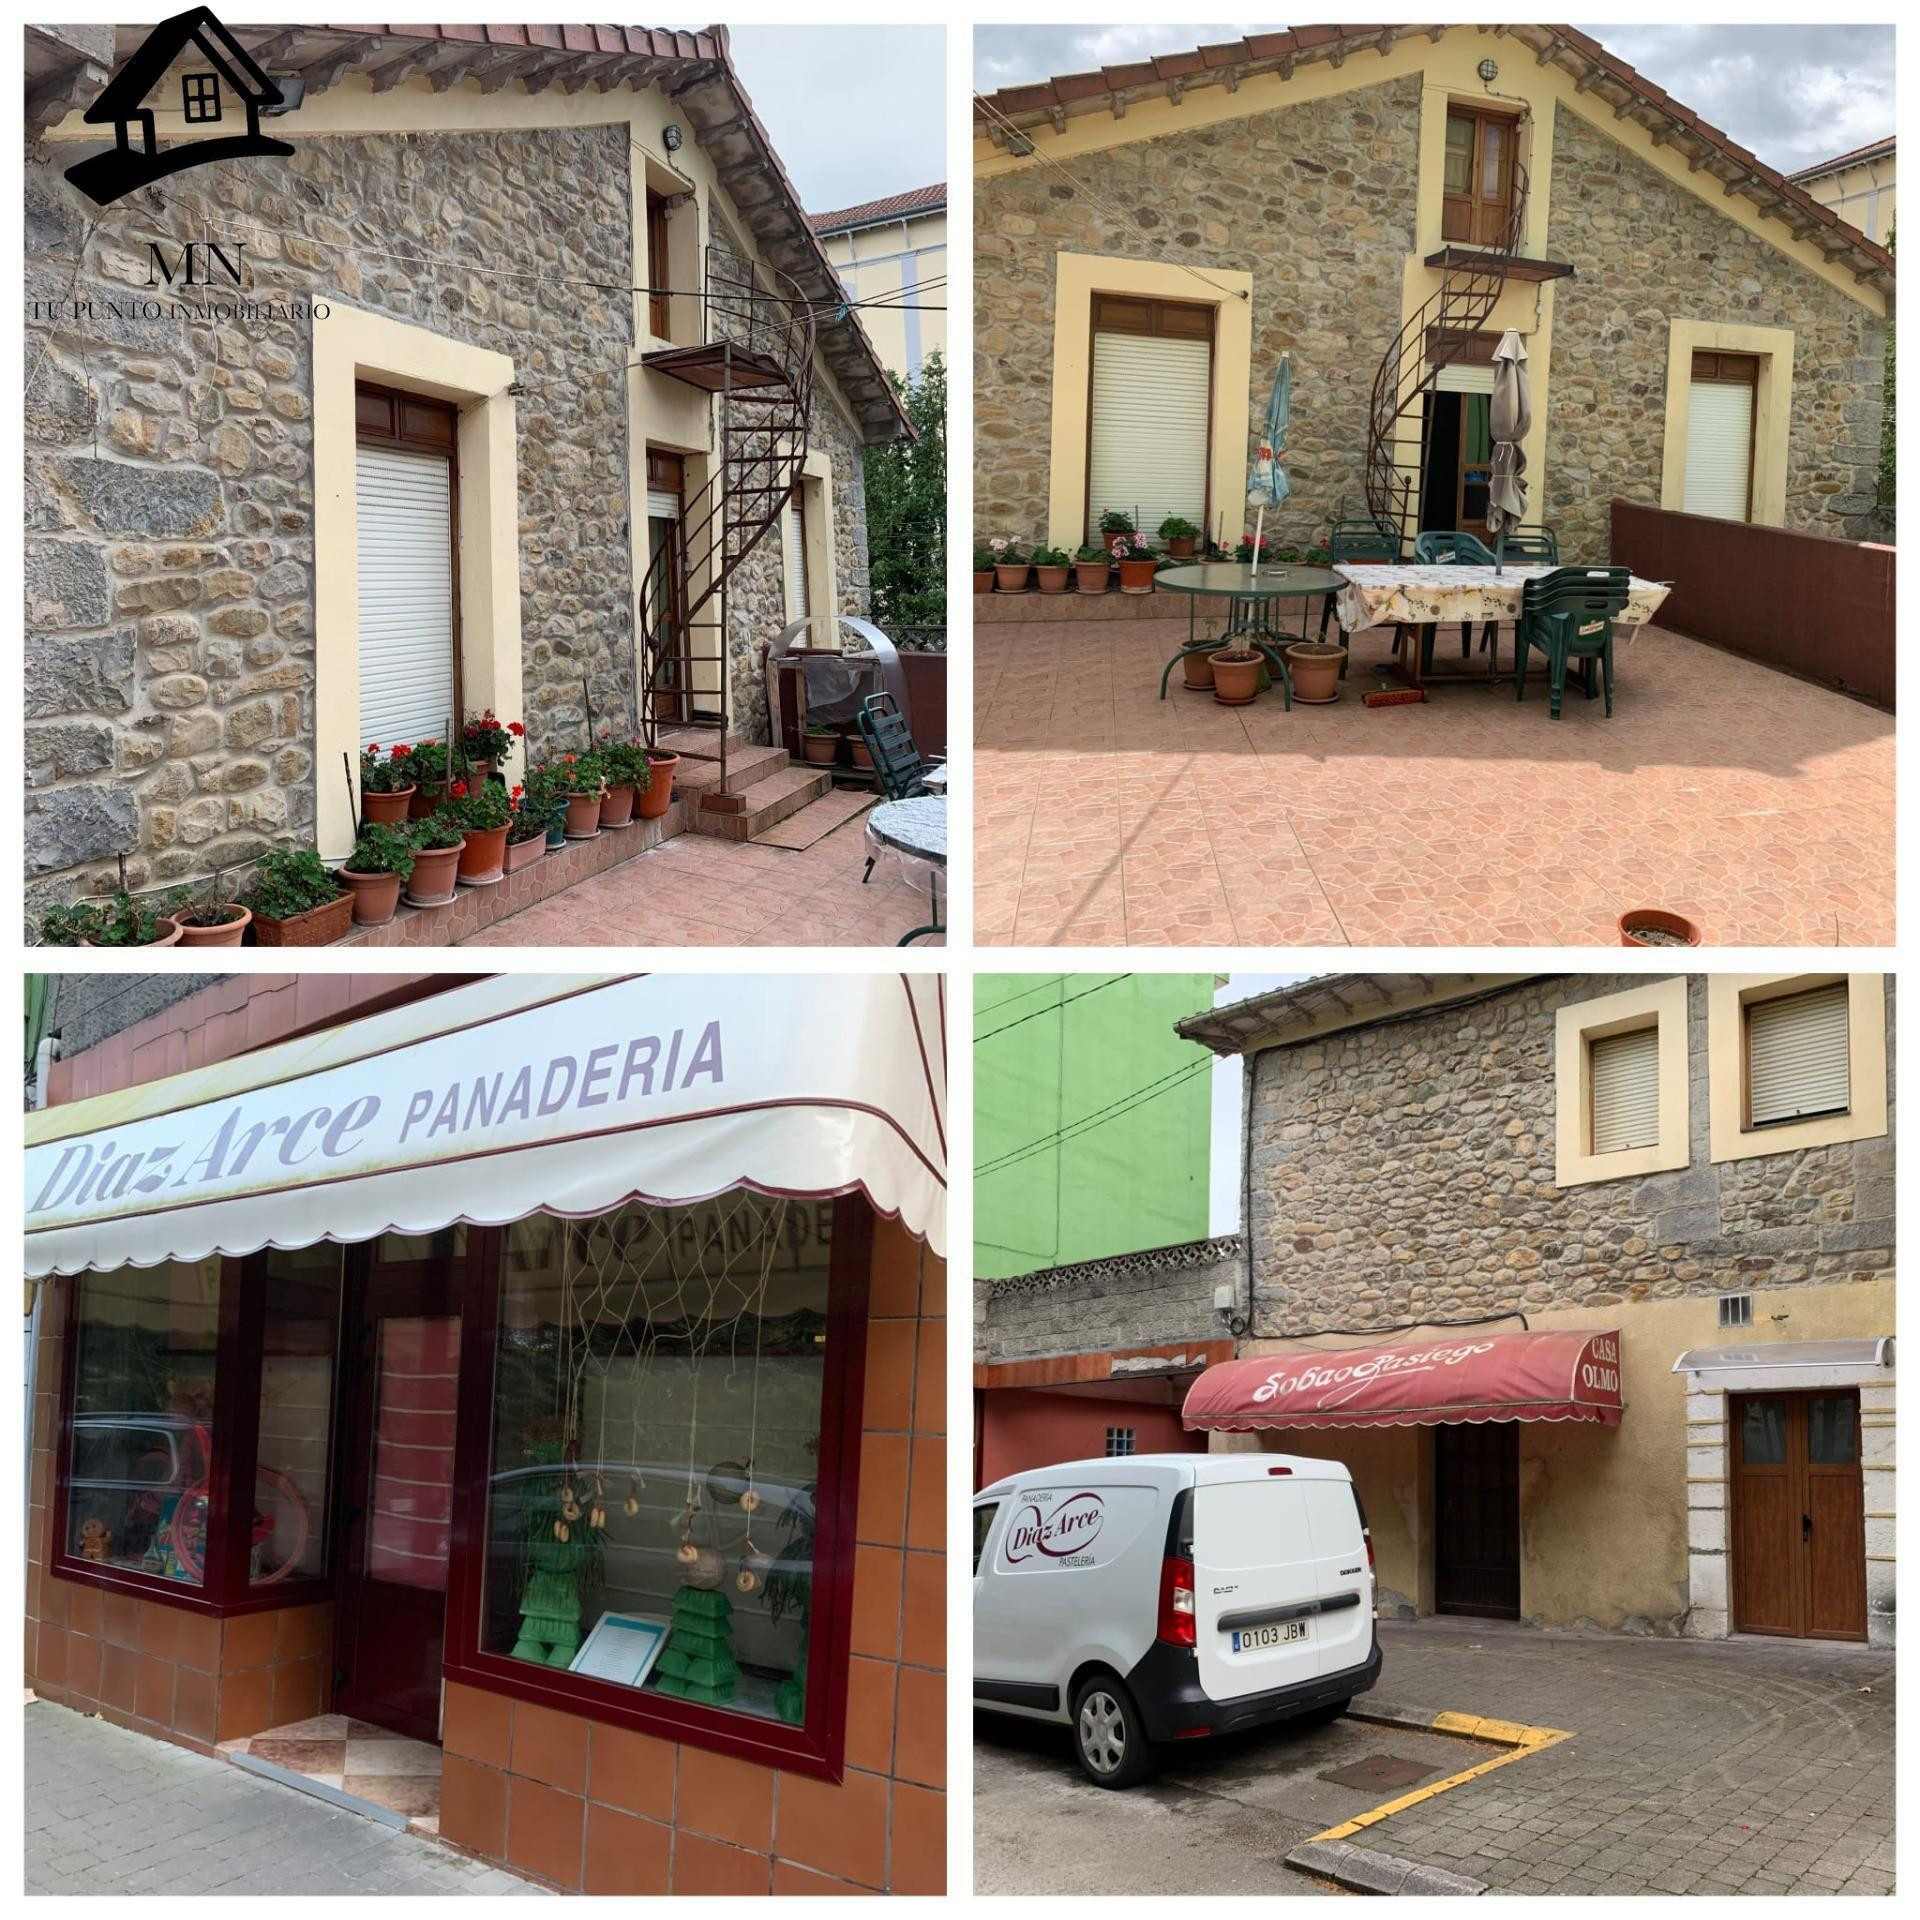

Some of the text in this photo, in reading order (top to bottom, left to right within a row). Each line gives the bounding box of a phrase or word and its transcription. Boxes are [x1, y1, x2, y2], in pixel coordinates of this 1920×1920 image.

[28, 1020, 724, 1214] Diaz Arce PANADERIA
[1591, 1337, 1618, 1364] CASA
[1252, 1343, 1495, 1403] Sobao Pasiego
[1582, 1363, 1618, 1392] OLMO
[1012, 1509, 1099, 1550] Diaz Arce
[1242, 1621, 1306, 1649] 0103 JBW
